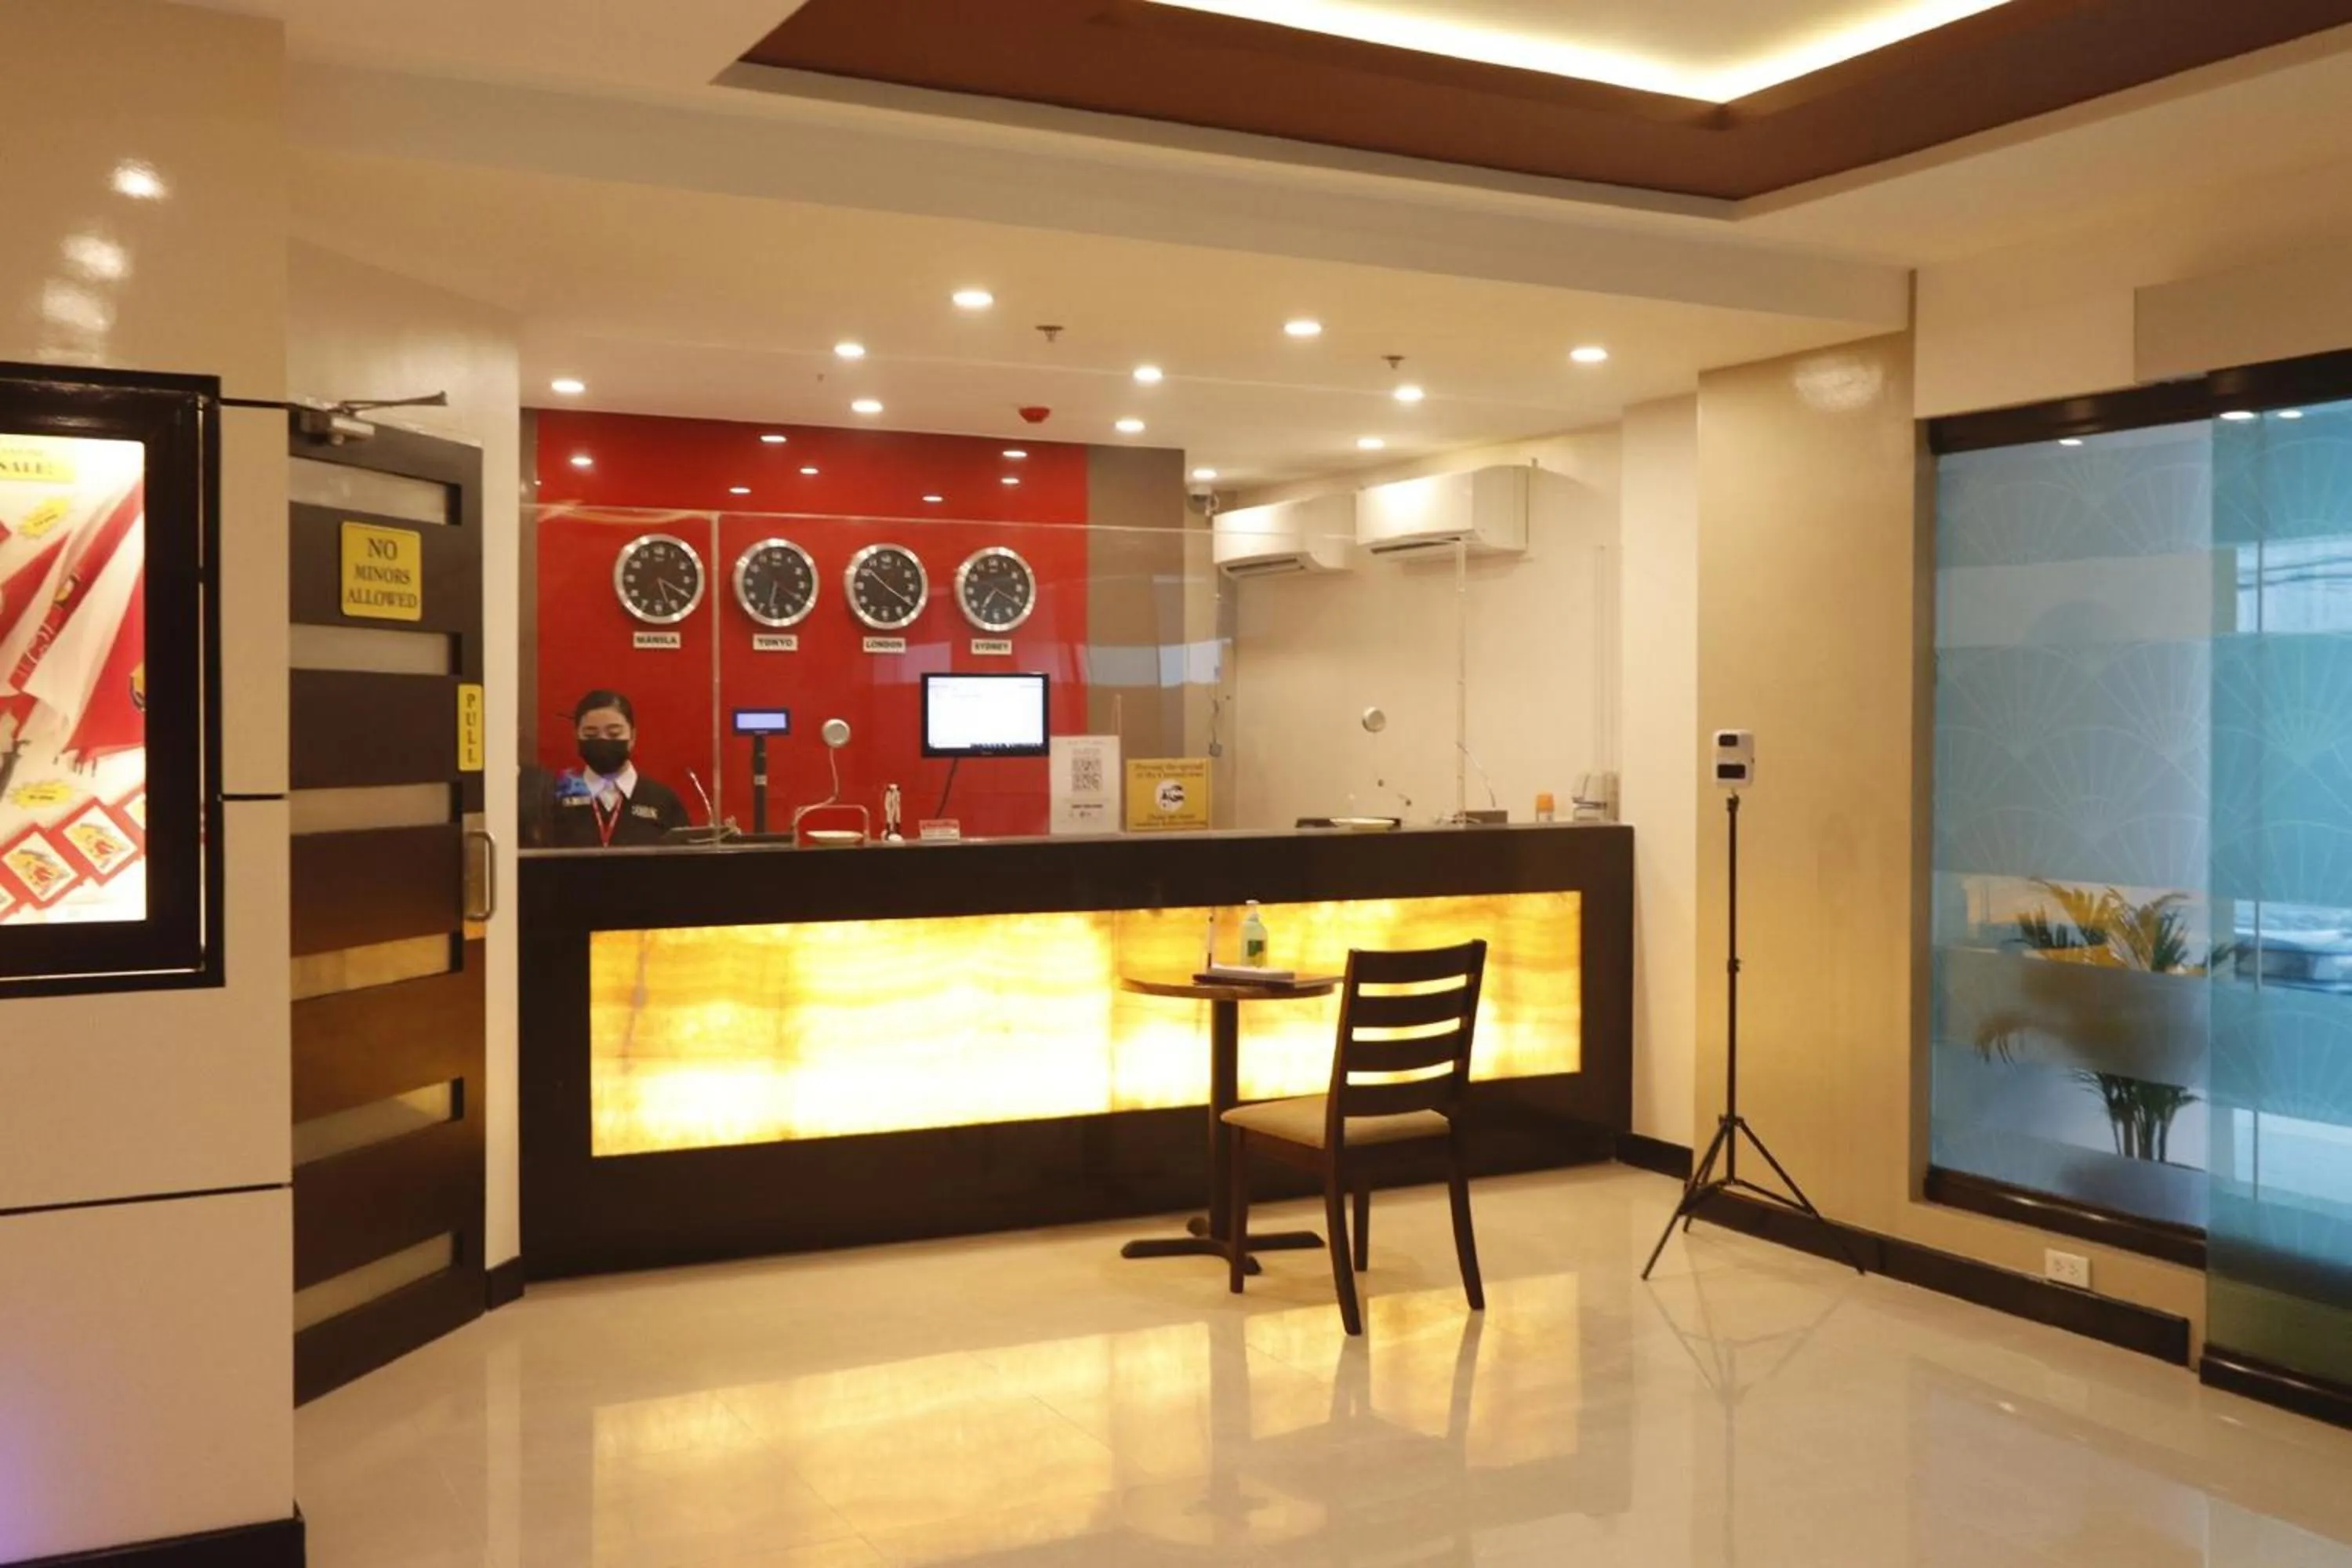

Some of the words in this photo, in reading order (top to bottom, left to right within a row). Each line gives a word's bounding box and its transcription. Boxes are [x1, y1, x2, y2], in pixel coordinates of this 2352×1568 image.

[367, 537, 397, 561] NO
[355, 563, 412, 585] MINORS
[347, 588, 418, 609] ALLOWED
[636, 635, 678, 644] MANILA
[757, 637, 793, 648] TOKYO
[866, 640, 902, 649] LONDON
[975, 641, 1009, 651] SYDNEY
[465, 692, 477, 764] PULL
